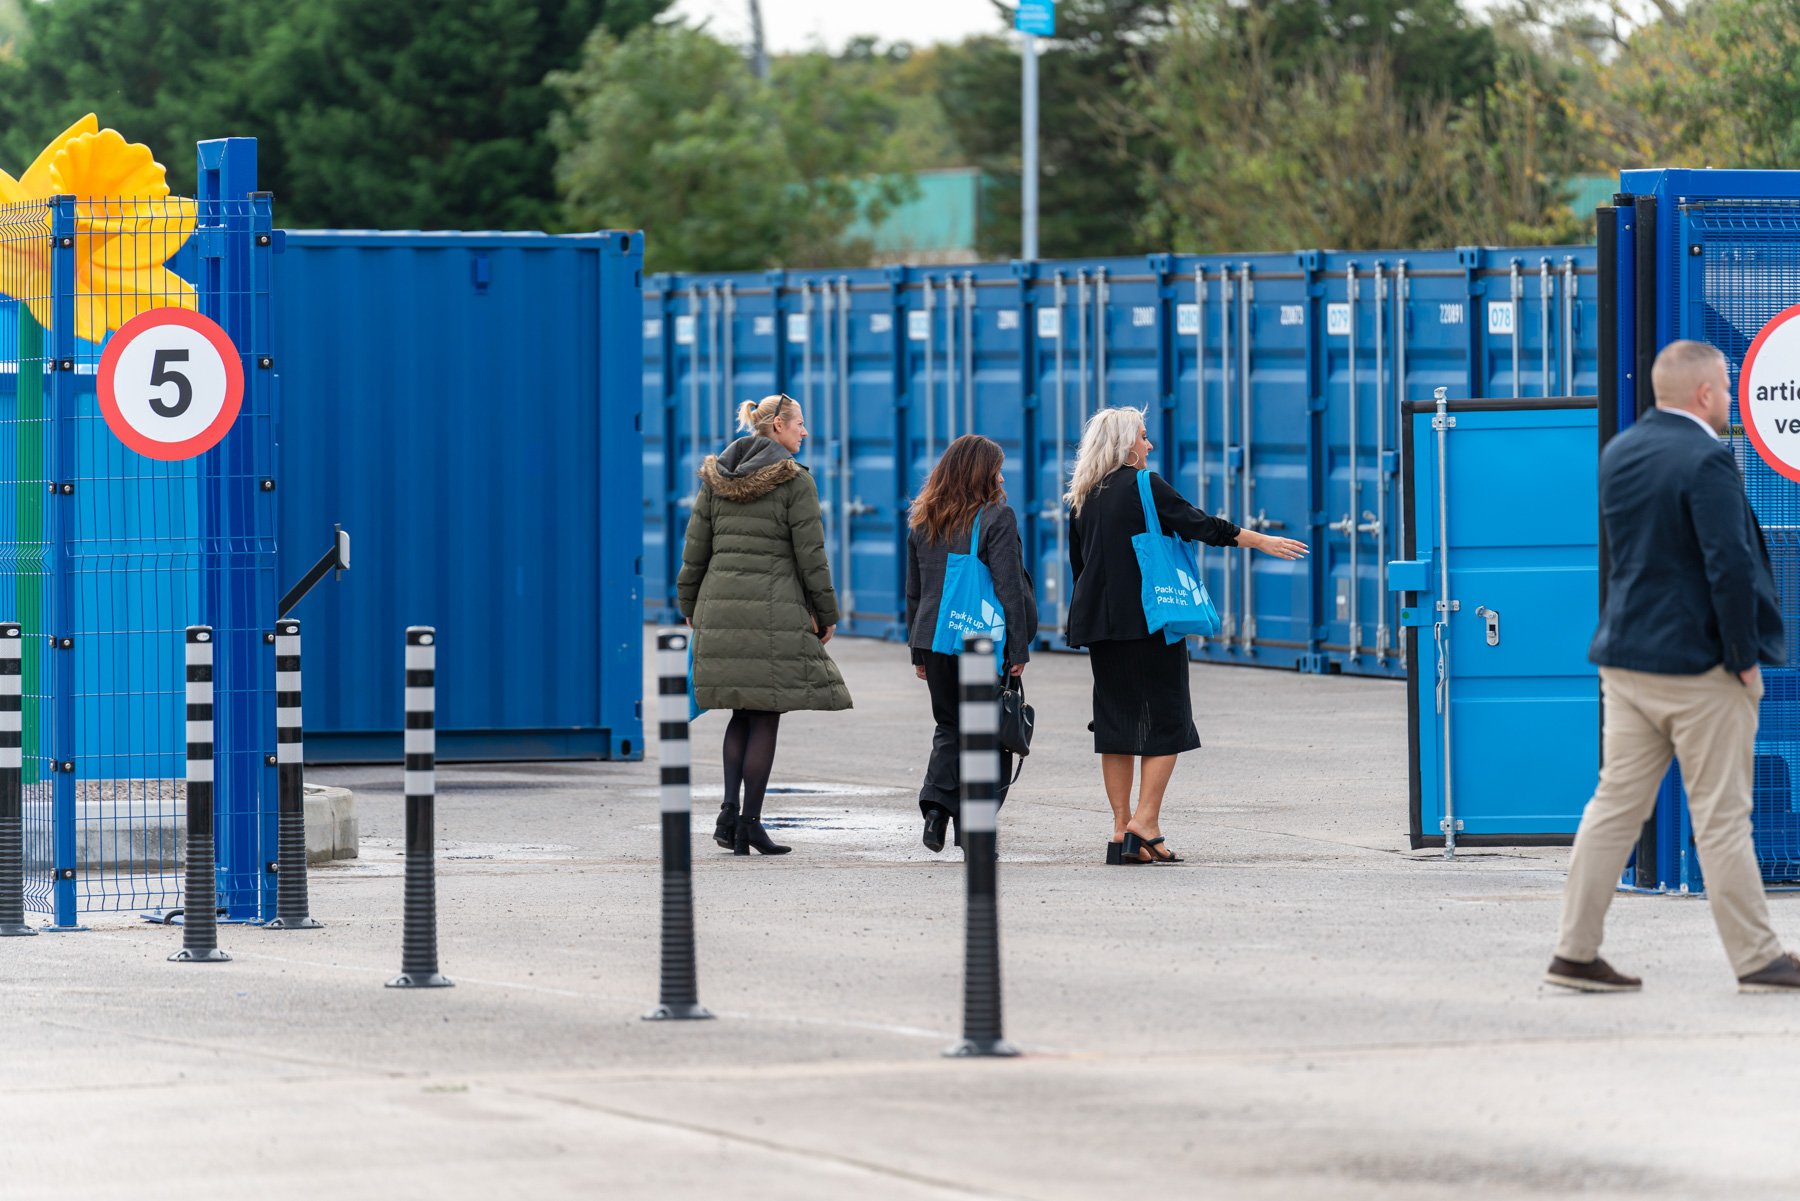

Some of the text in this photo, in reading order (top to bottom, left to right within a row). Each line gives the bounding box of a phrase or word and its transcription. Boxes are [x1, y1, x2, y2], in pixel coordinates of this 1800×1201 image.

[1330, 309, 1349, 328] 079
[1491, 308, 1511, 327] 078
[148, 349, 193, 418] 5
[1756, 380, 1800, 401] arti
[1154, 586, 1174, 594] Pack
[948, 620, 963, 630] Pak
[973, 620, 985, 630] up.
